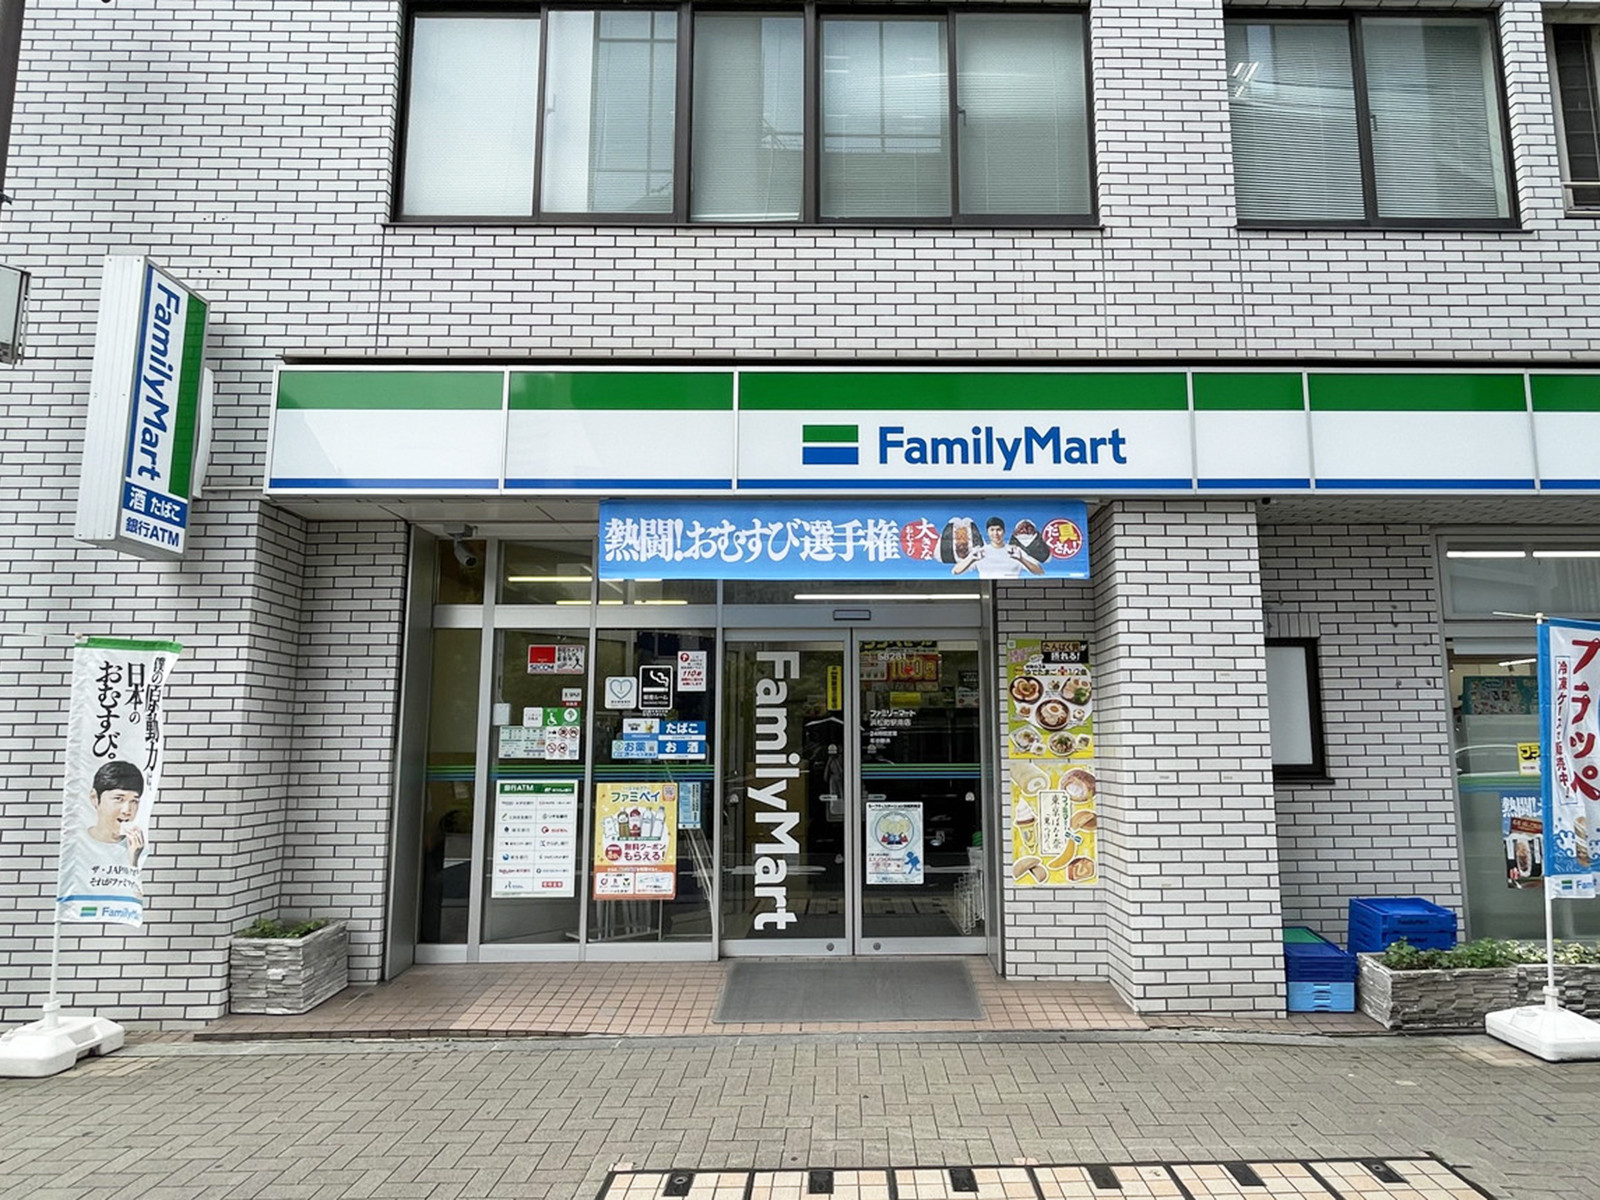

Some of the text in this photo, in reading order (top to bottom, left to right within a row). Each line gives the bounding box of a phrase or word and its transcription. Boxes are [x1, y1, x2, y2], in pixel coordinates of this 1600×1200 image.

[137, 283, 180, 481] FamilyMart
[878, 426, 1127, 471] FamilyMart
[129, 487, 180, 522] 酒 たばこ
[126, 517, 179, 547] 銀行ATM
[605, 517, 900, 562] 熱闘!おむすび選手権
[125, 662, 146, 724] 日本の
[666, 722, 699, 734] たばこ
[611, 791, 660, 803] ファミペイ
[747, 651, 800, 931] FamilyMart
[624, 851, 665, 861] もらえる!
